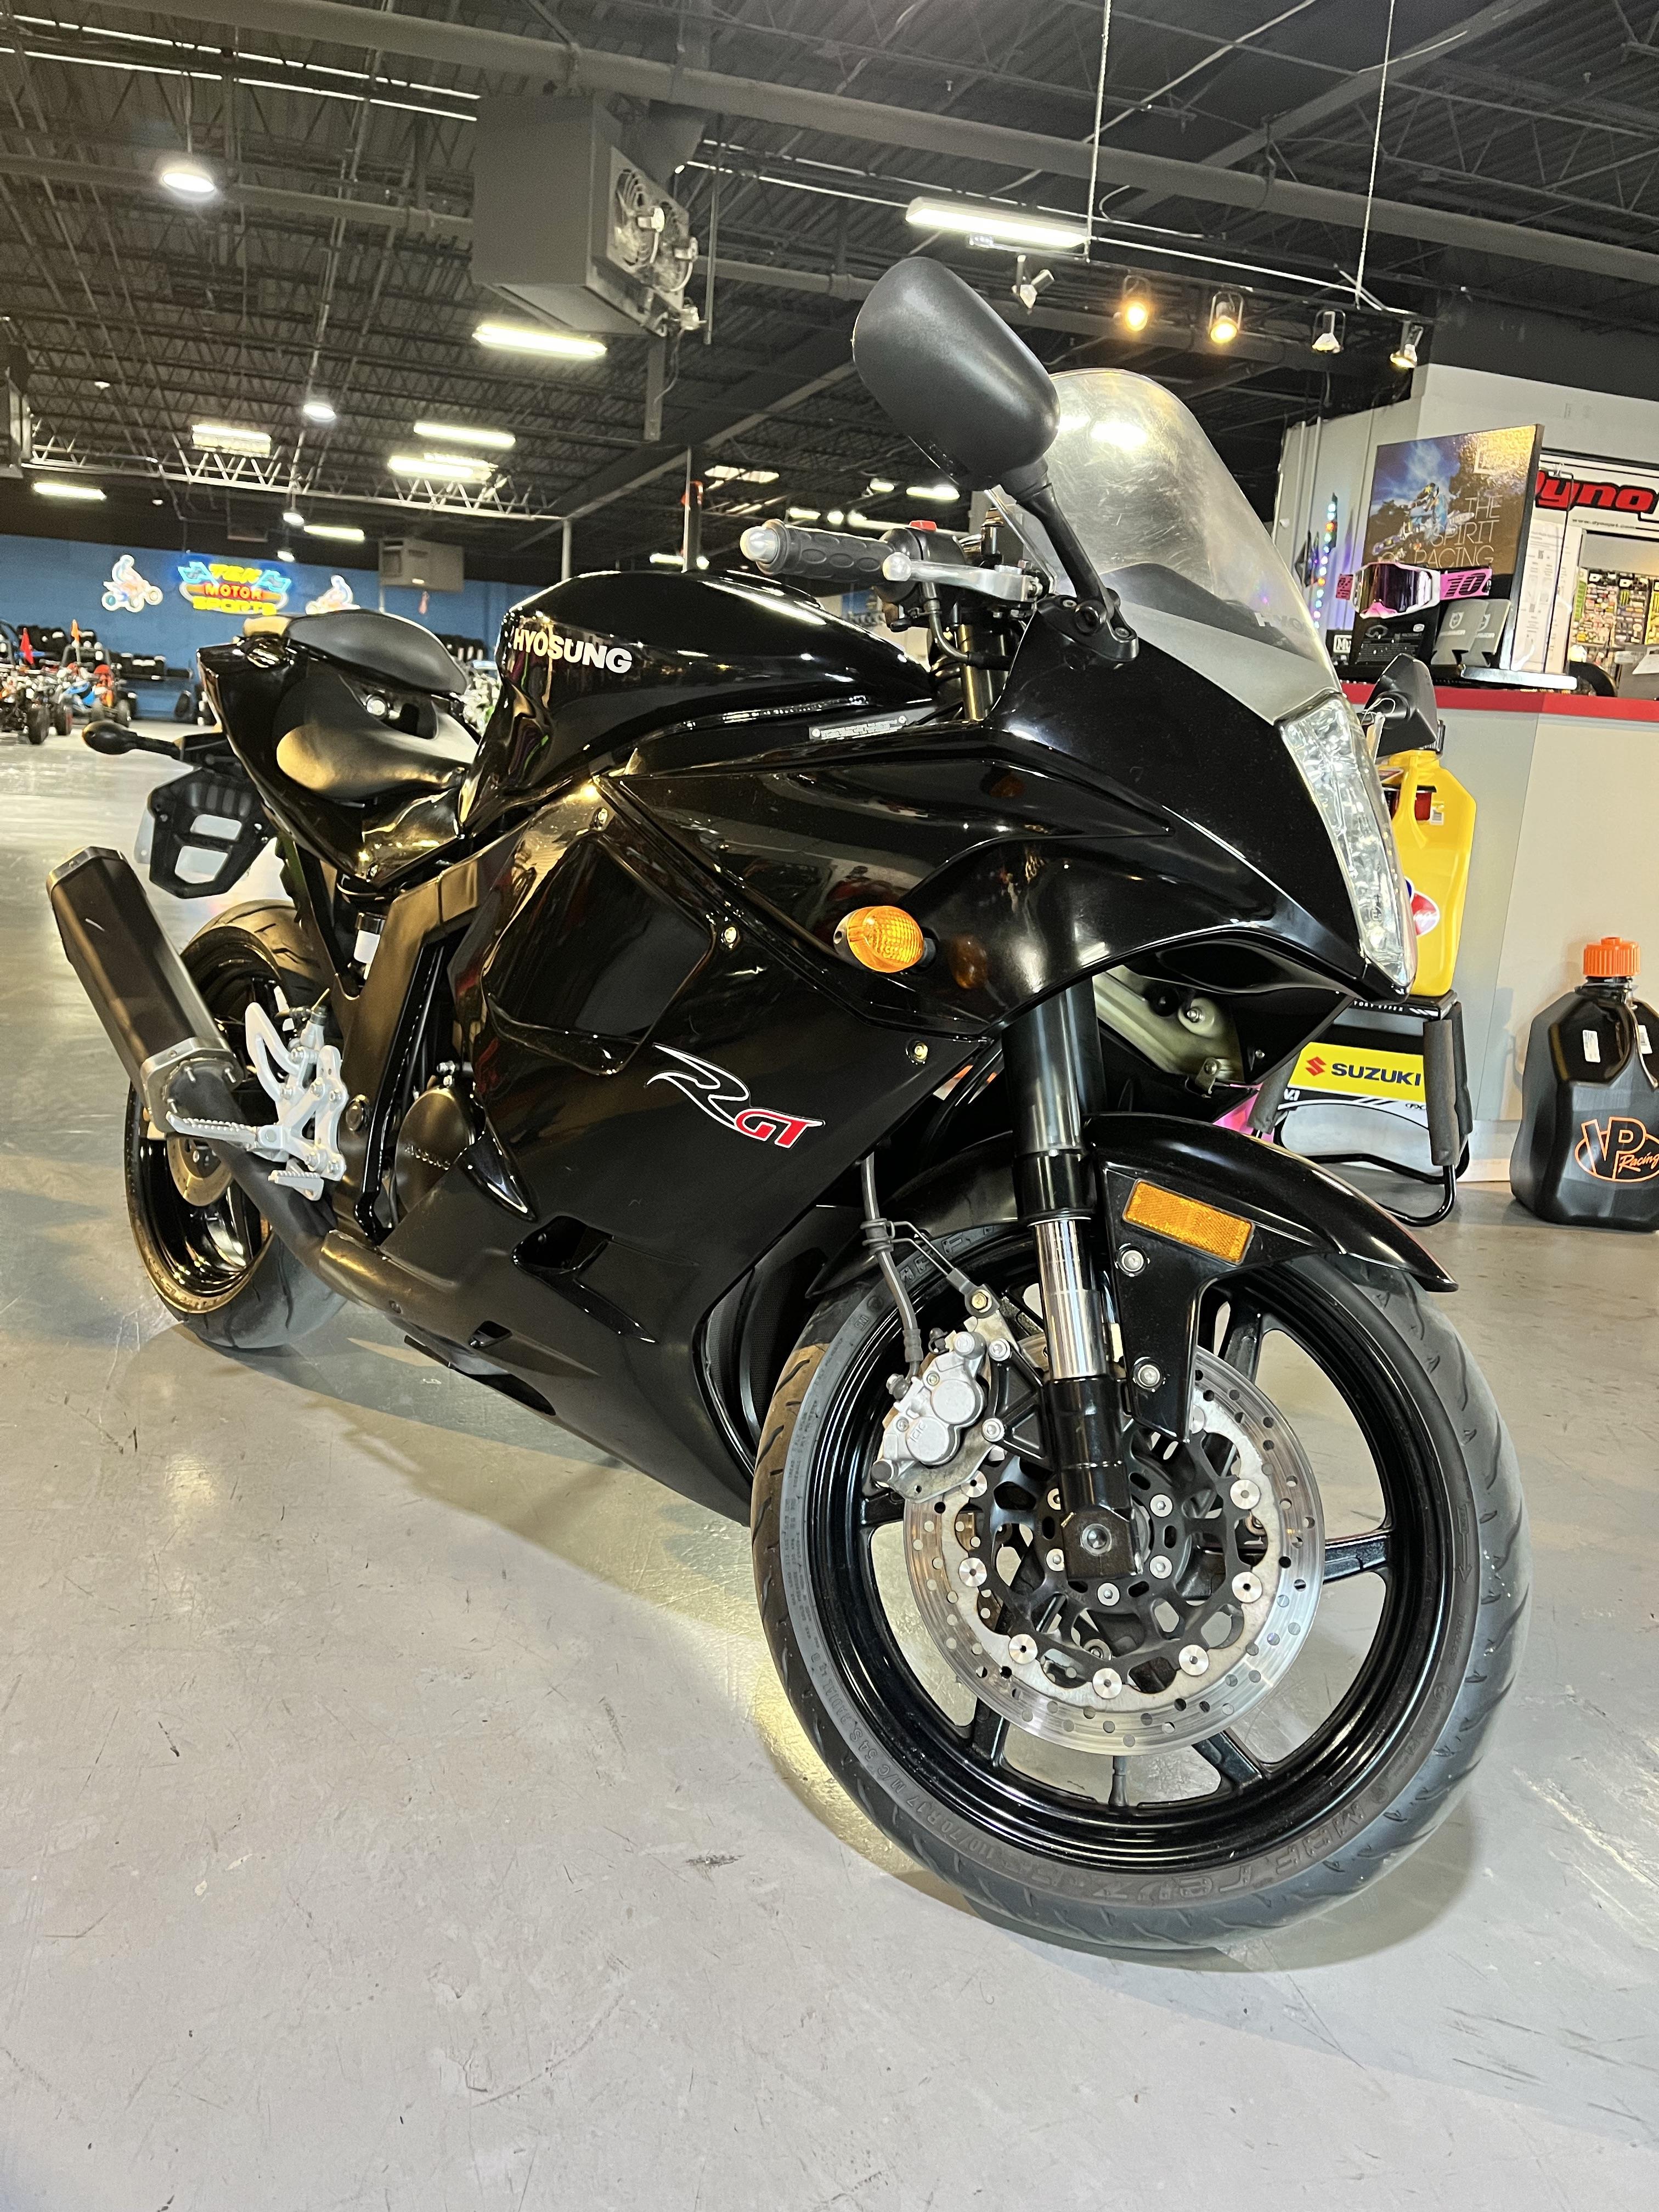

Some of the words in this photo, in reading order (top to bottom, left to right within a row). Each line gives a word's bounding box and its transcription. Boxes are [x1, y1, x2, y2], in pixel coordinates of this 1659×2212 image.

[1465, 493, 1503, 518] THE
[1431, 520, 1499, 548] SPIRIT
[205, 583, 262, 599] MOTOR
[192, 596, 276, 616] SPORTS
[513, 627, 632, 674] HYOSUNG
[1331, 1063, 1421, 1086] SUZUKI
[1581, 1116, 1647, 1181] VP
[1618, 1152, 1659, 1173] Racing
[822, 1680, 851, 1724] RADIAL
[858, 1741, 878, 1760] 54
[877, 1764, 905, 1793] M/C
[907, 1794, 926, 1813] 17
[941, 1822, 995, 1859] 110/70
